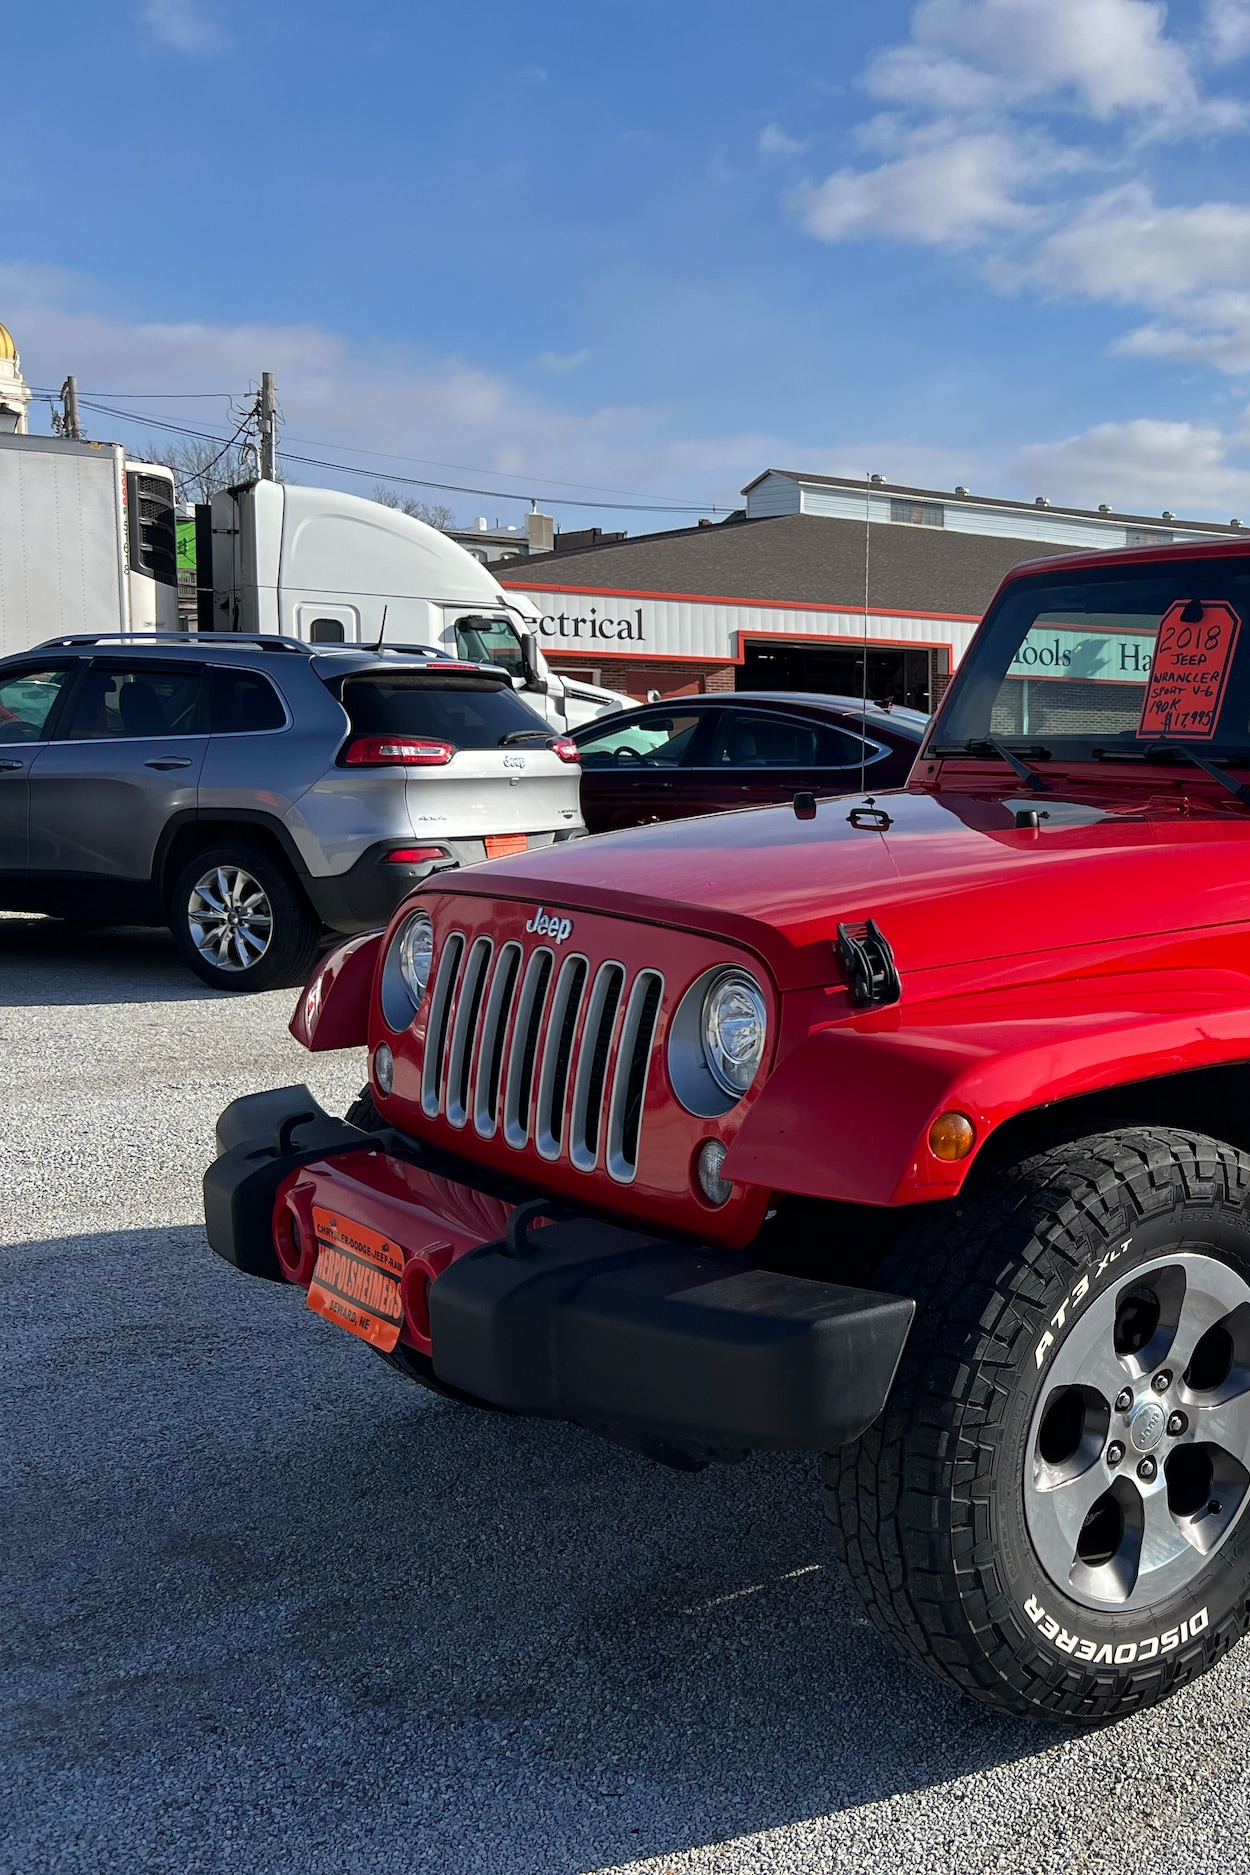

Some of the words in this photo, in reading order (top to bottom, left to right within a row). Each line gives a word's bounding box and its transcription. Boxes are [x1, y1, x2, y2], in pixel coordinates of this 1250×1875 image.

[1159, 625, 1221, 653] 2018
[1170, 653, 1207, 666] JEEP
[1151, 686, 1187, 698] SPORT
[1193, 685, 1214, 697] V-6
[1149, 699, 1181, 715] 190K
[1160, 710, 1214, 731] $17,995
[503, 755, 526, 769] Jeep
[526, 907, 573, 945] Jeep
[315, 1244, 403, 1319] HERPOLSHEIMERS
[329, 1300, 358, 1326] SEWARD,
[359, 1316, 371, 1330] NE
[1035, 1274, 1090, 1370] AT3
[1094, 1238, 1133, 1279] XLT
[1024, 1594, 1209, 1664] DISCOVERER
